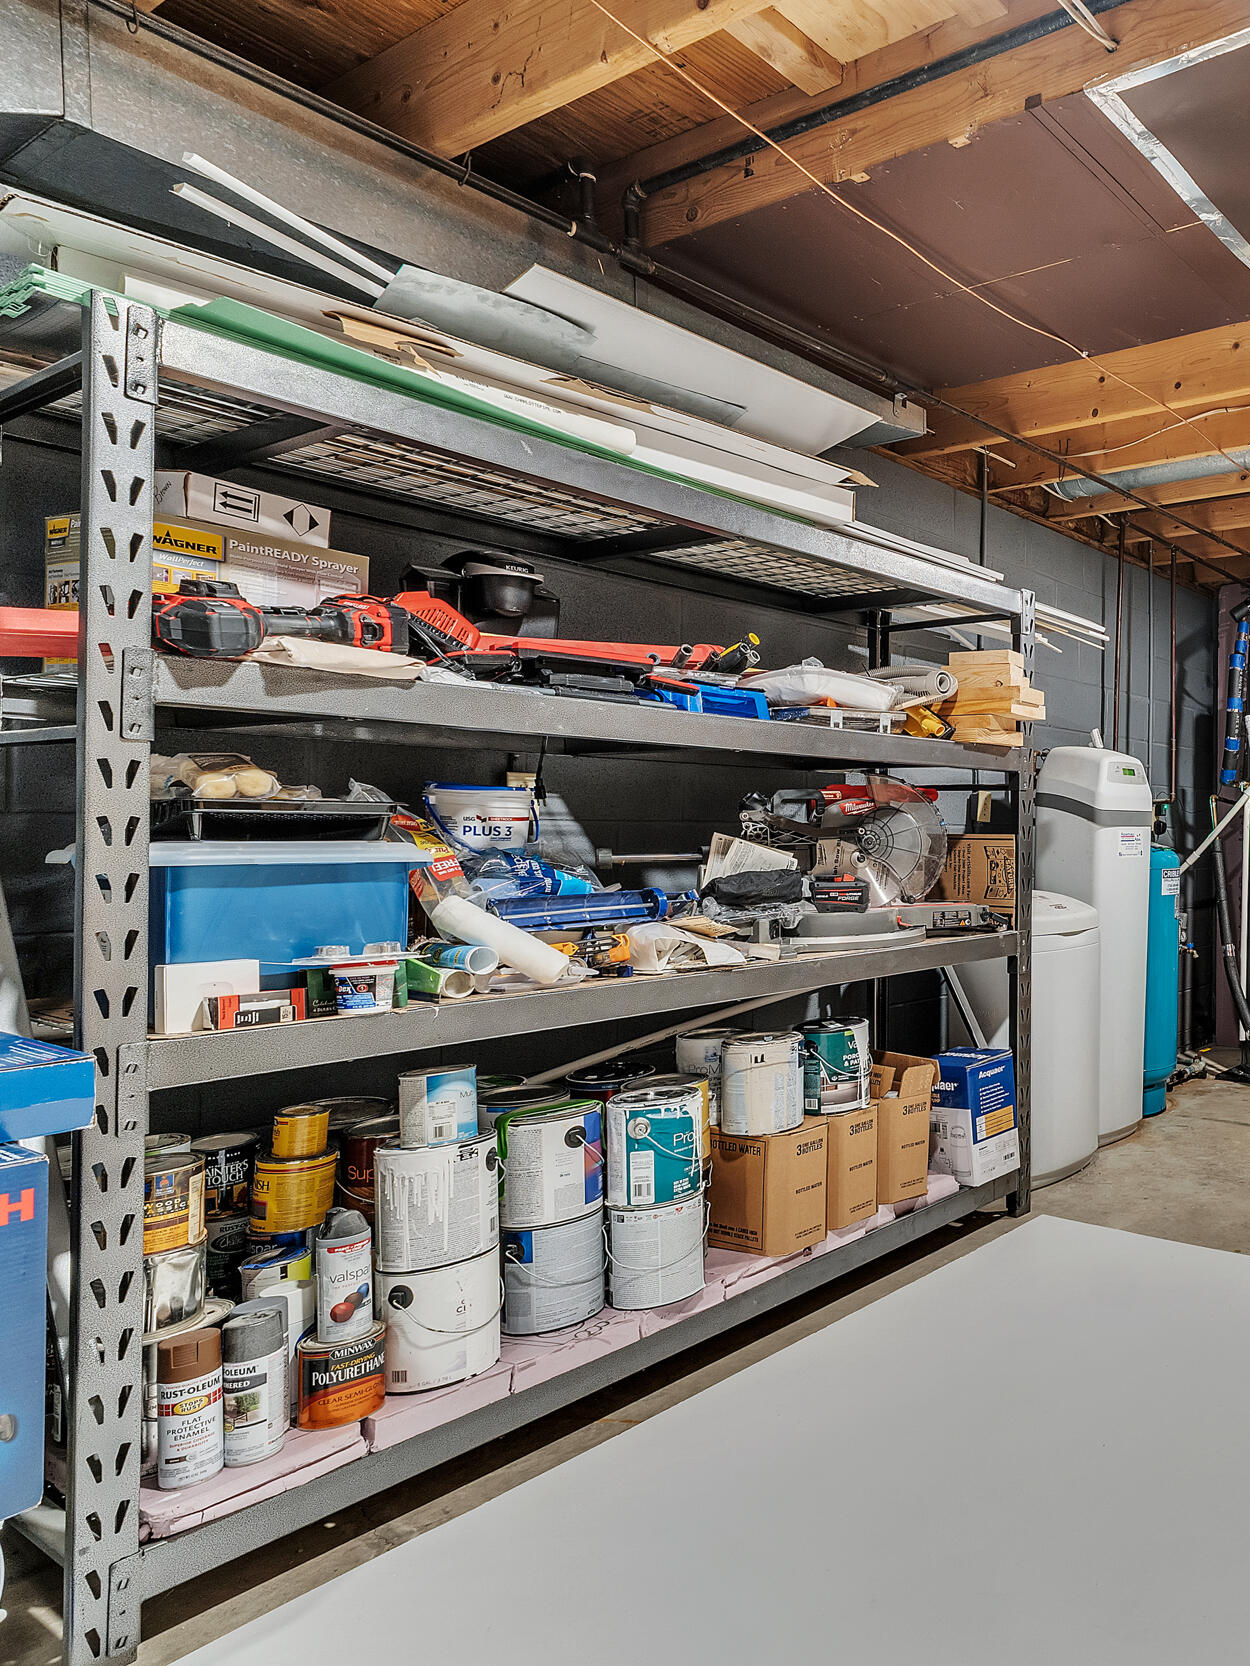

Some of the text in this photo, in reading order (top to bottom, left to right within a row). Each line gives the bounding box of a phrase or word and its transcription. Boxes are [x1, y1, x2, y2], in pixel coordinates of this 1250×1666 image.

[159, 553, 205, 568] WallPerfect
[230, 538, 309, 564] PaintREADY
[312, 556, 359, 574] Sprayer
[505, 565, 529, 573] KEURIG
[845, 802, 875, 813] Milwaukee
[462, 825, 512, 837] PLUS 3
[432, 858, 460, 872] FREE!
[843, 1054, 861, 1063] PORC
[688, 1064, 721, 1074] ProM
[978, 1064, 1006, 1080] Acquaer
[902, 1105, 908, 1116] 3
[908, 1105, 927, 1115] BOTTLES
[849, 1125, 855, 1136] 3
[854, 1124, 873, 1135] BOTTLES
[738, 1142, 761, 1156] WATER
[796, 1144, 802, 1156] 3
[802, 1143, 823, 1155] BOTTLES
[901, 1139, 926, 1150] BOTTLED WATER
[205, 1159, 249, 1178] AINTER'S
[863, 1159, 873, 1167] WATER
[206, 1171, 245, 1186] TOUCH
[347, 1166, 374, 1183] Sup
[795, 1181, 823, 1194] BOTTLED WATER
[334, 1339, 374, 1359] MINWAX
[330, 1352, 376, 1371] FAST-DRYING
[223, 1366, 257, 1377] OLEUM
[312, 1352, 385, 1386] POLYURETHANE
[161, 1377, 221, 1400] RUST-OLEUM
[318, 1382, 384, 1406] CLEAR SEMI-GLOS
[179, 1398, 204, 1410] STOPS
[180, 1403, 202, 1413] RUST
[166, 1416, 216, 1435] PROTECTIVE
[181, 1415, 202, 1427] FLAT
[173, 1427, 210, 1441] ENAMEL
